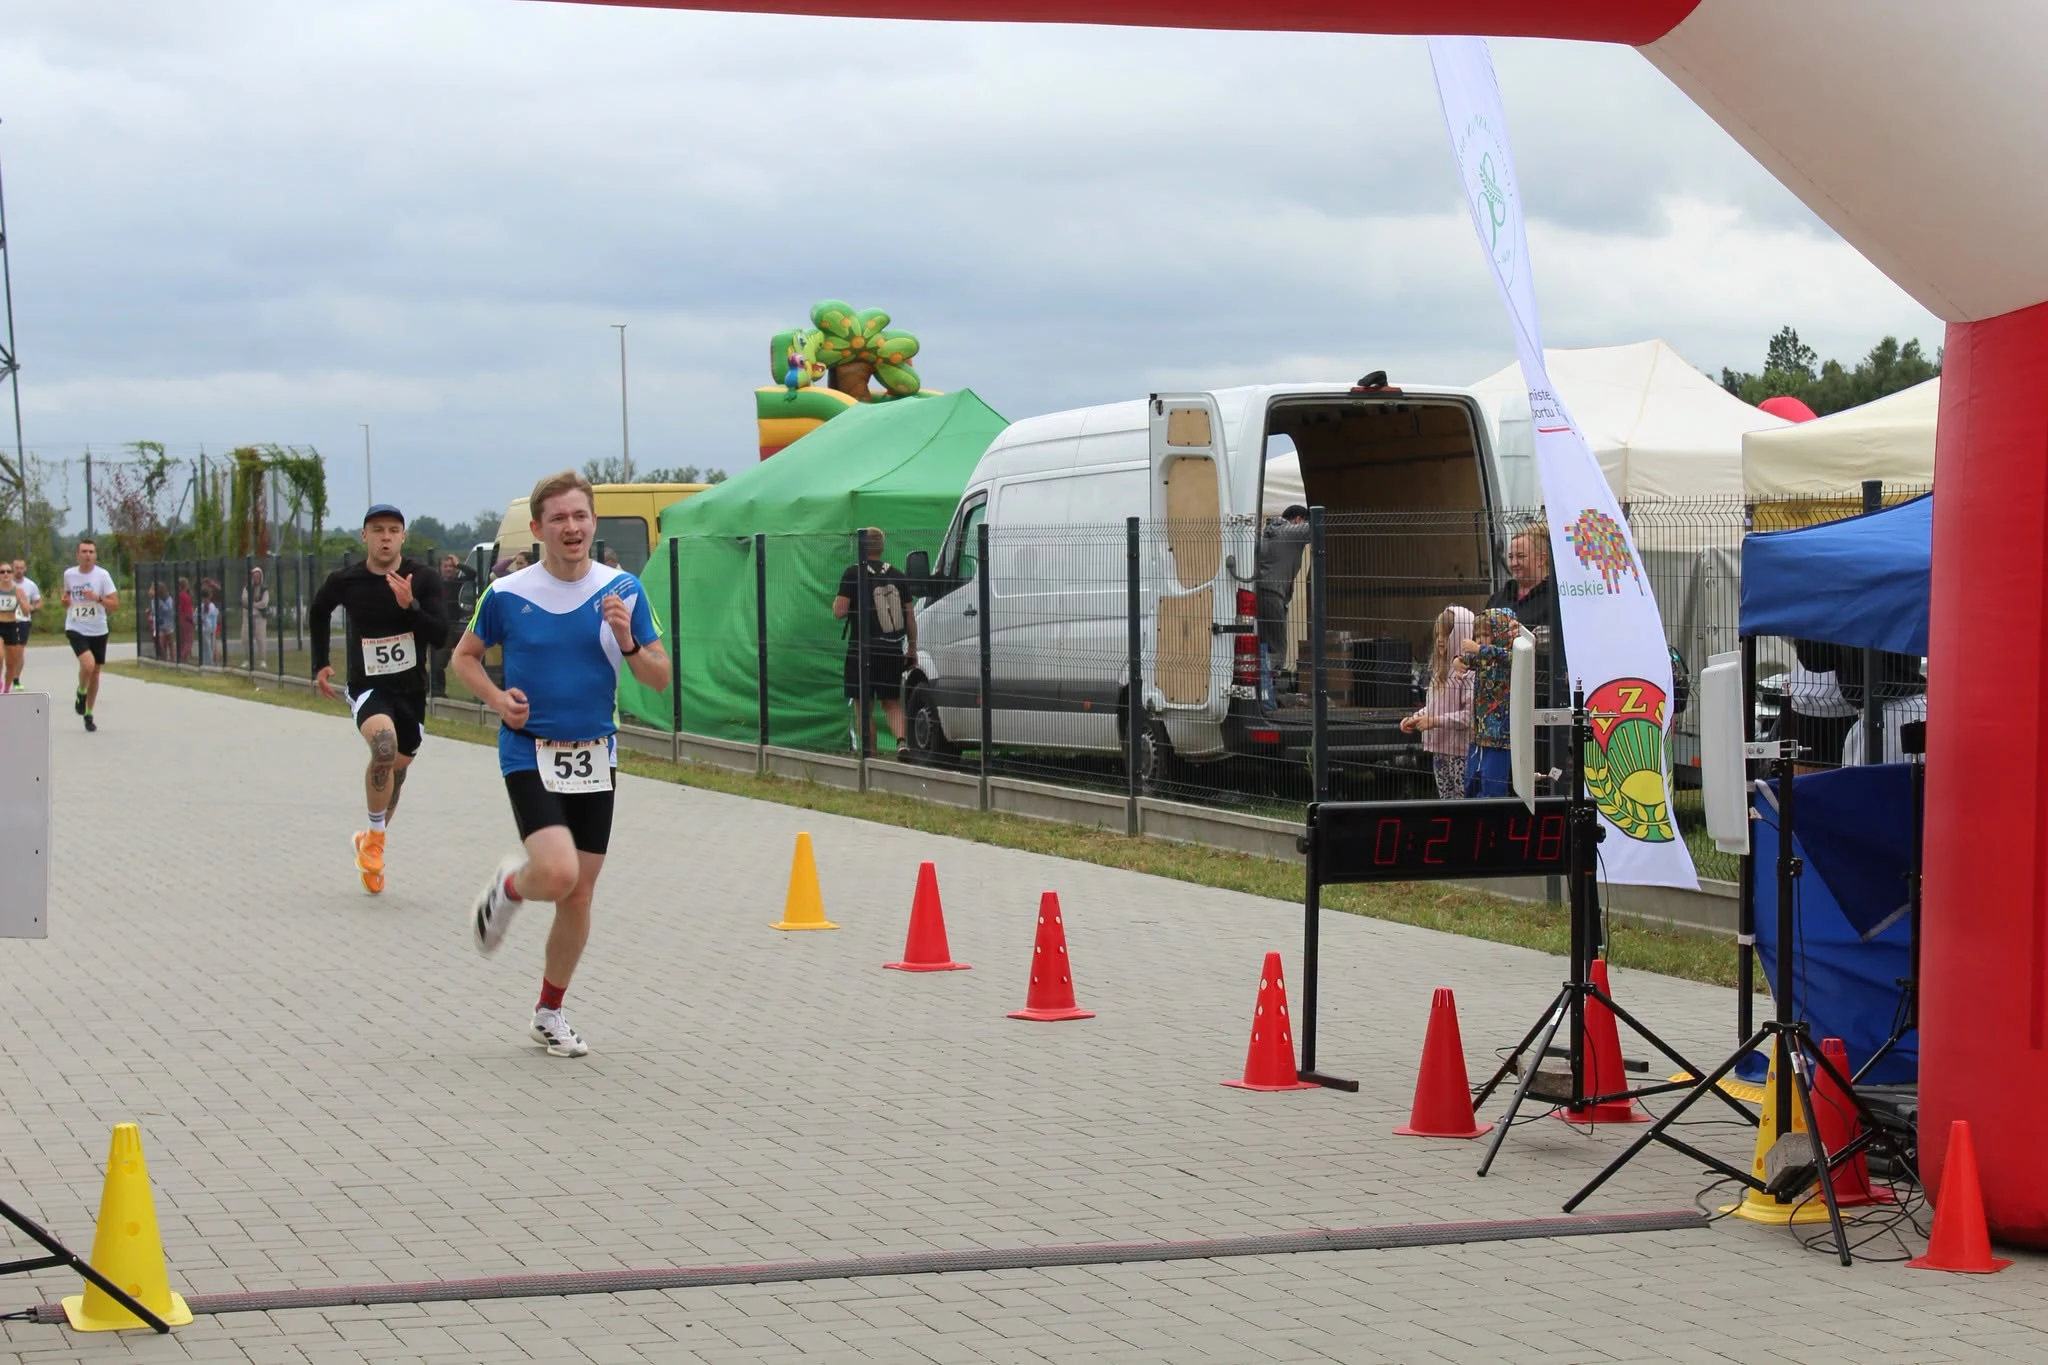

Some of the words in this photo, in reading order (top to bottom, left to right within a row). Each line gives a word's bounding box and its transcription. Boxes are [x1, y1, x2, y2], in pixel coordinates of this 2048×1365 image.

[75, 607, 96, 617] 124
[375, 642, 406, 665] 56
[553, 750, 594, 780] 53
[1373, 815, 1565, 866] 0:21:48
